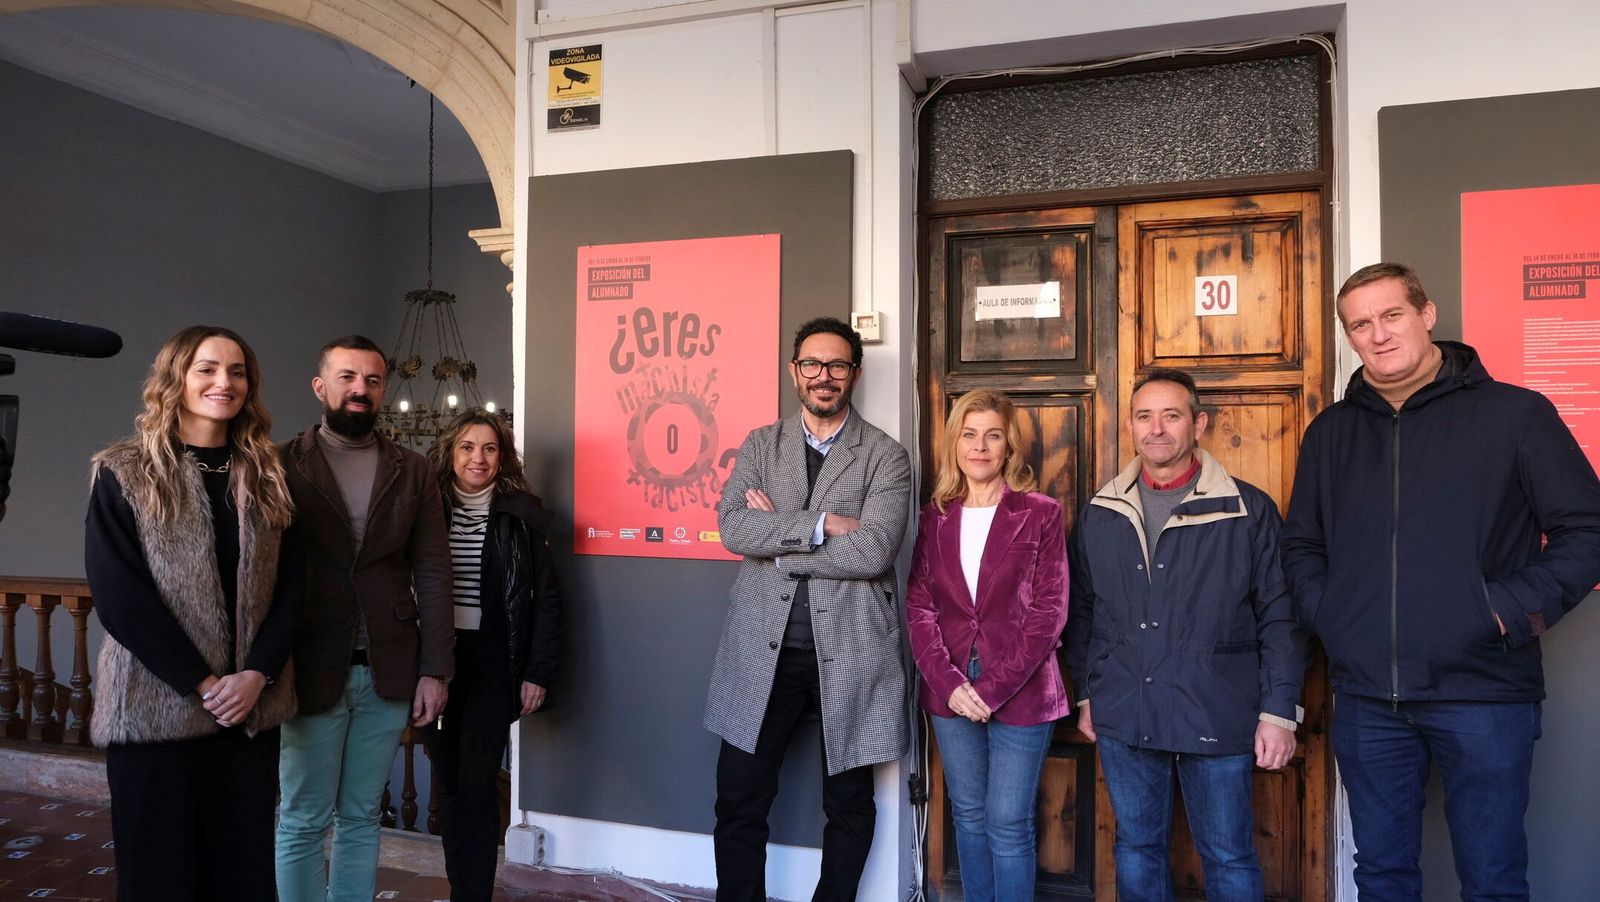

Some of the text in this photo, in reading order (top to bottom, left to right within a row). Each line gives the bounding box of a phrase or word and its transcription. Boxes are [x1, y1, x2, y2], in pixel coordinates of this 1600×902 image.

[566, 47, 585, 56] ZONA
[550, 53, 600, 65] VIDEOVIGILADA
[592, 267, 645, 281] EXPOSICIÓN DEL
[1529, 264, 1600, 279] EXPOSICIÓN DEL
[592, 286, 629, 299] ALUMNADO
[1202, 280, 1230, 310] 30
[1529, 284, 1580, 298] ALUMNADO
[983, 296, 1054, 307] AULA DE INFORMA
[609, 306, 722, 375] ¿eres
